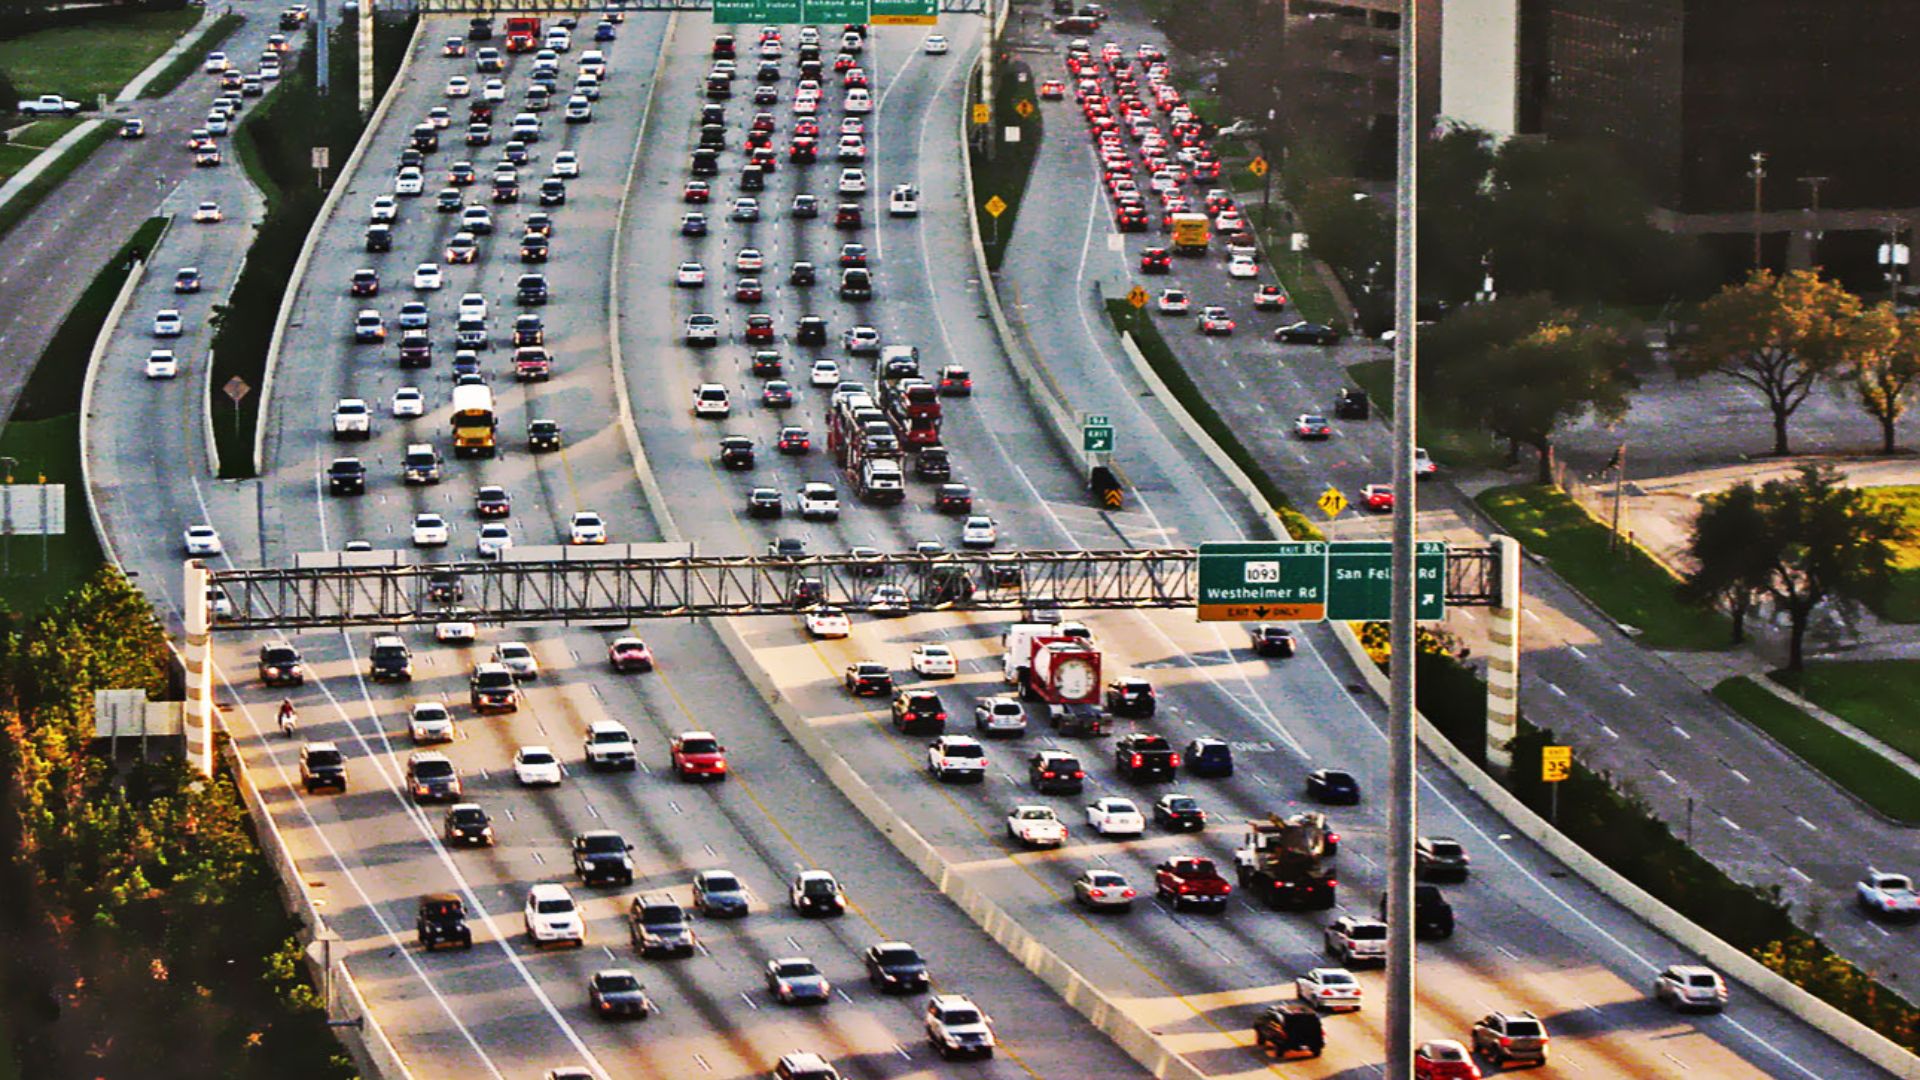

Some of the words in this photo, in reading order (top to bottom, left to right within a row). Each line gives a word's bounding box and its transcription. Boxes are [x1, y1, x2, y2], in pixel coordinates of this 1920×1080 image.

[1088, 429, 1108, 437] EXIT
[1280, 546, 1299, 554] EXIT
[1423, 543, 1440, 553] 9A
[1247, 569, 1278, 580] 1093
[1336, 568, 1362, 579] San
[1368, 567, 1392, 579] Fel
[1418, 567, 1437, 579] Rd
[1207, 586, 1293, 599] Westheimer
[1299, 586, 1318, 599] Rd
[1227, 608, 1250, 617] EXIT
[1273, 608, 1299, 616] ONLY
[1548, 760, 1569, 773] 35
